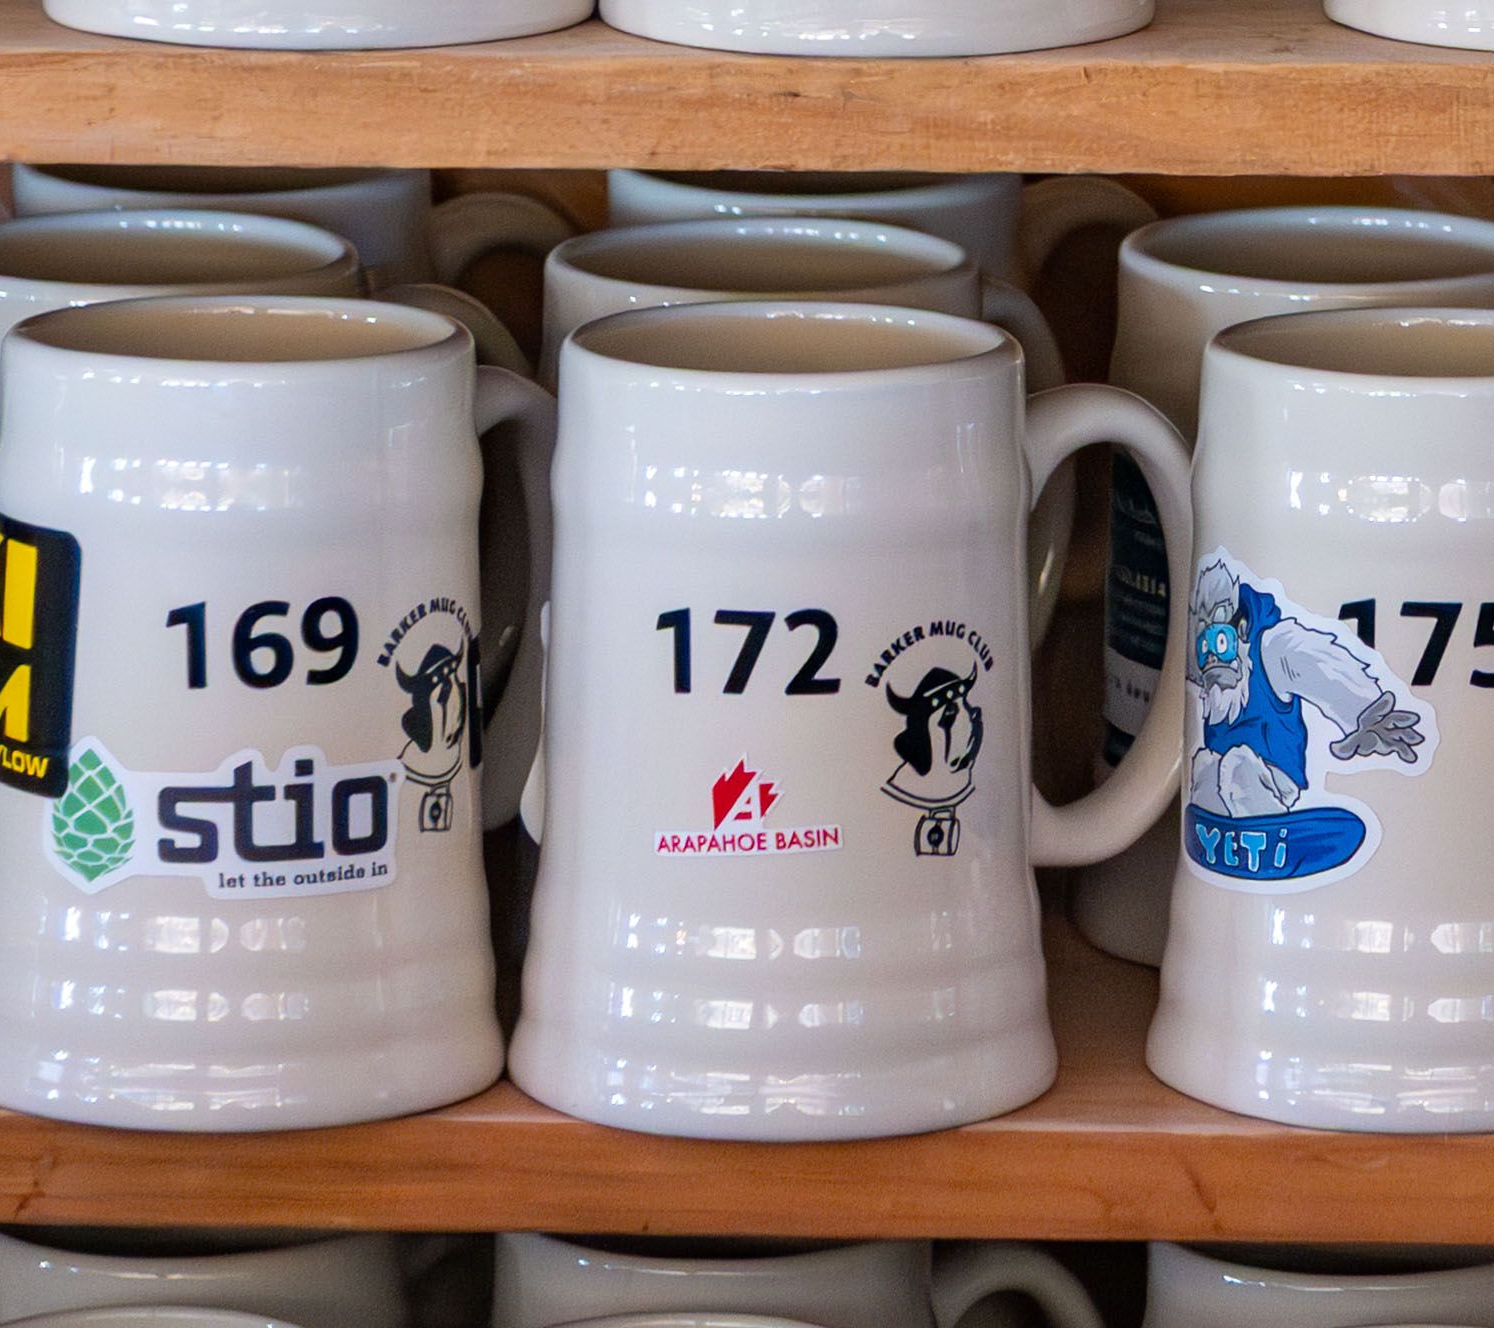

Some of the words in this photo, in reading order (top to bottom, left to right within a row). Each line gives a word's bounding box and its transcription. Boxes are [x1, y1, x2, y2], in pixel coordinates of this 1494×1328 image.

[165, 595, 360, 690] 169
[656, 607, 842, 695] 172
[864, 625, 925, 688] BARKER
[929, 621, 966, 644] MUG
[966, 631, 994, 674] CLUB
[157, 757, 389, 863] stio
[656, 831, 768, 855] ARAPAHOE
[774, 828, 841, 852] BASIN
[217, 870, 248, 890] let
[253, 869, 287, 888] the
[293, 863, 367, 886] outside
[370, 861, 389, 880] in
[1196, 822, 1288, 873] YETi
